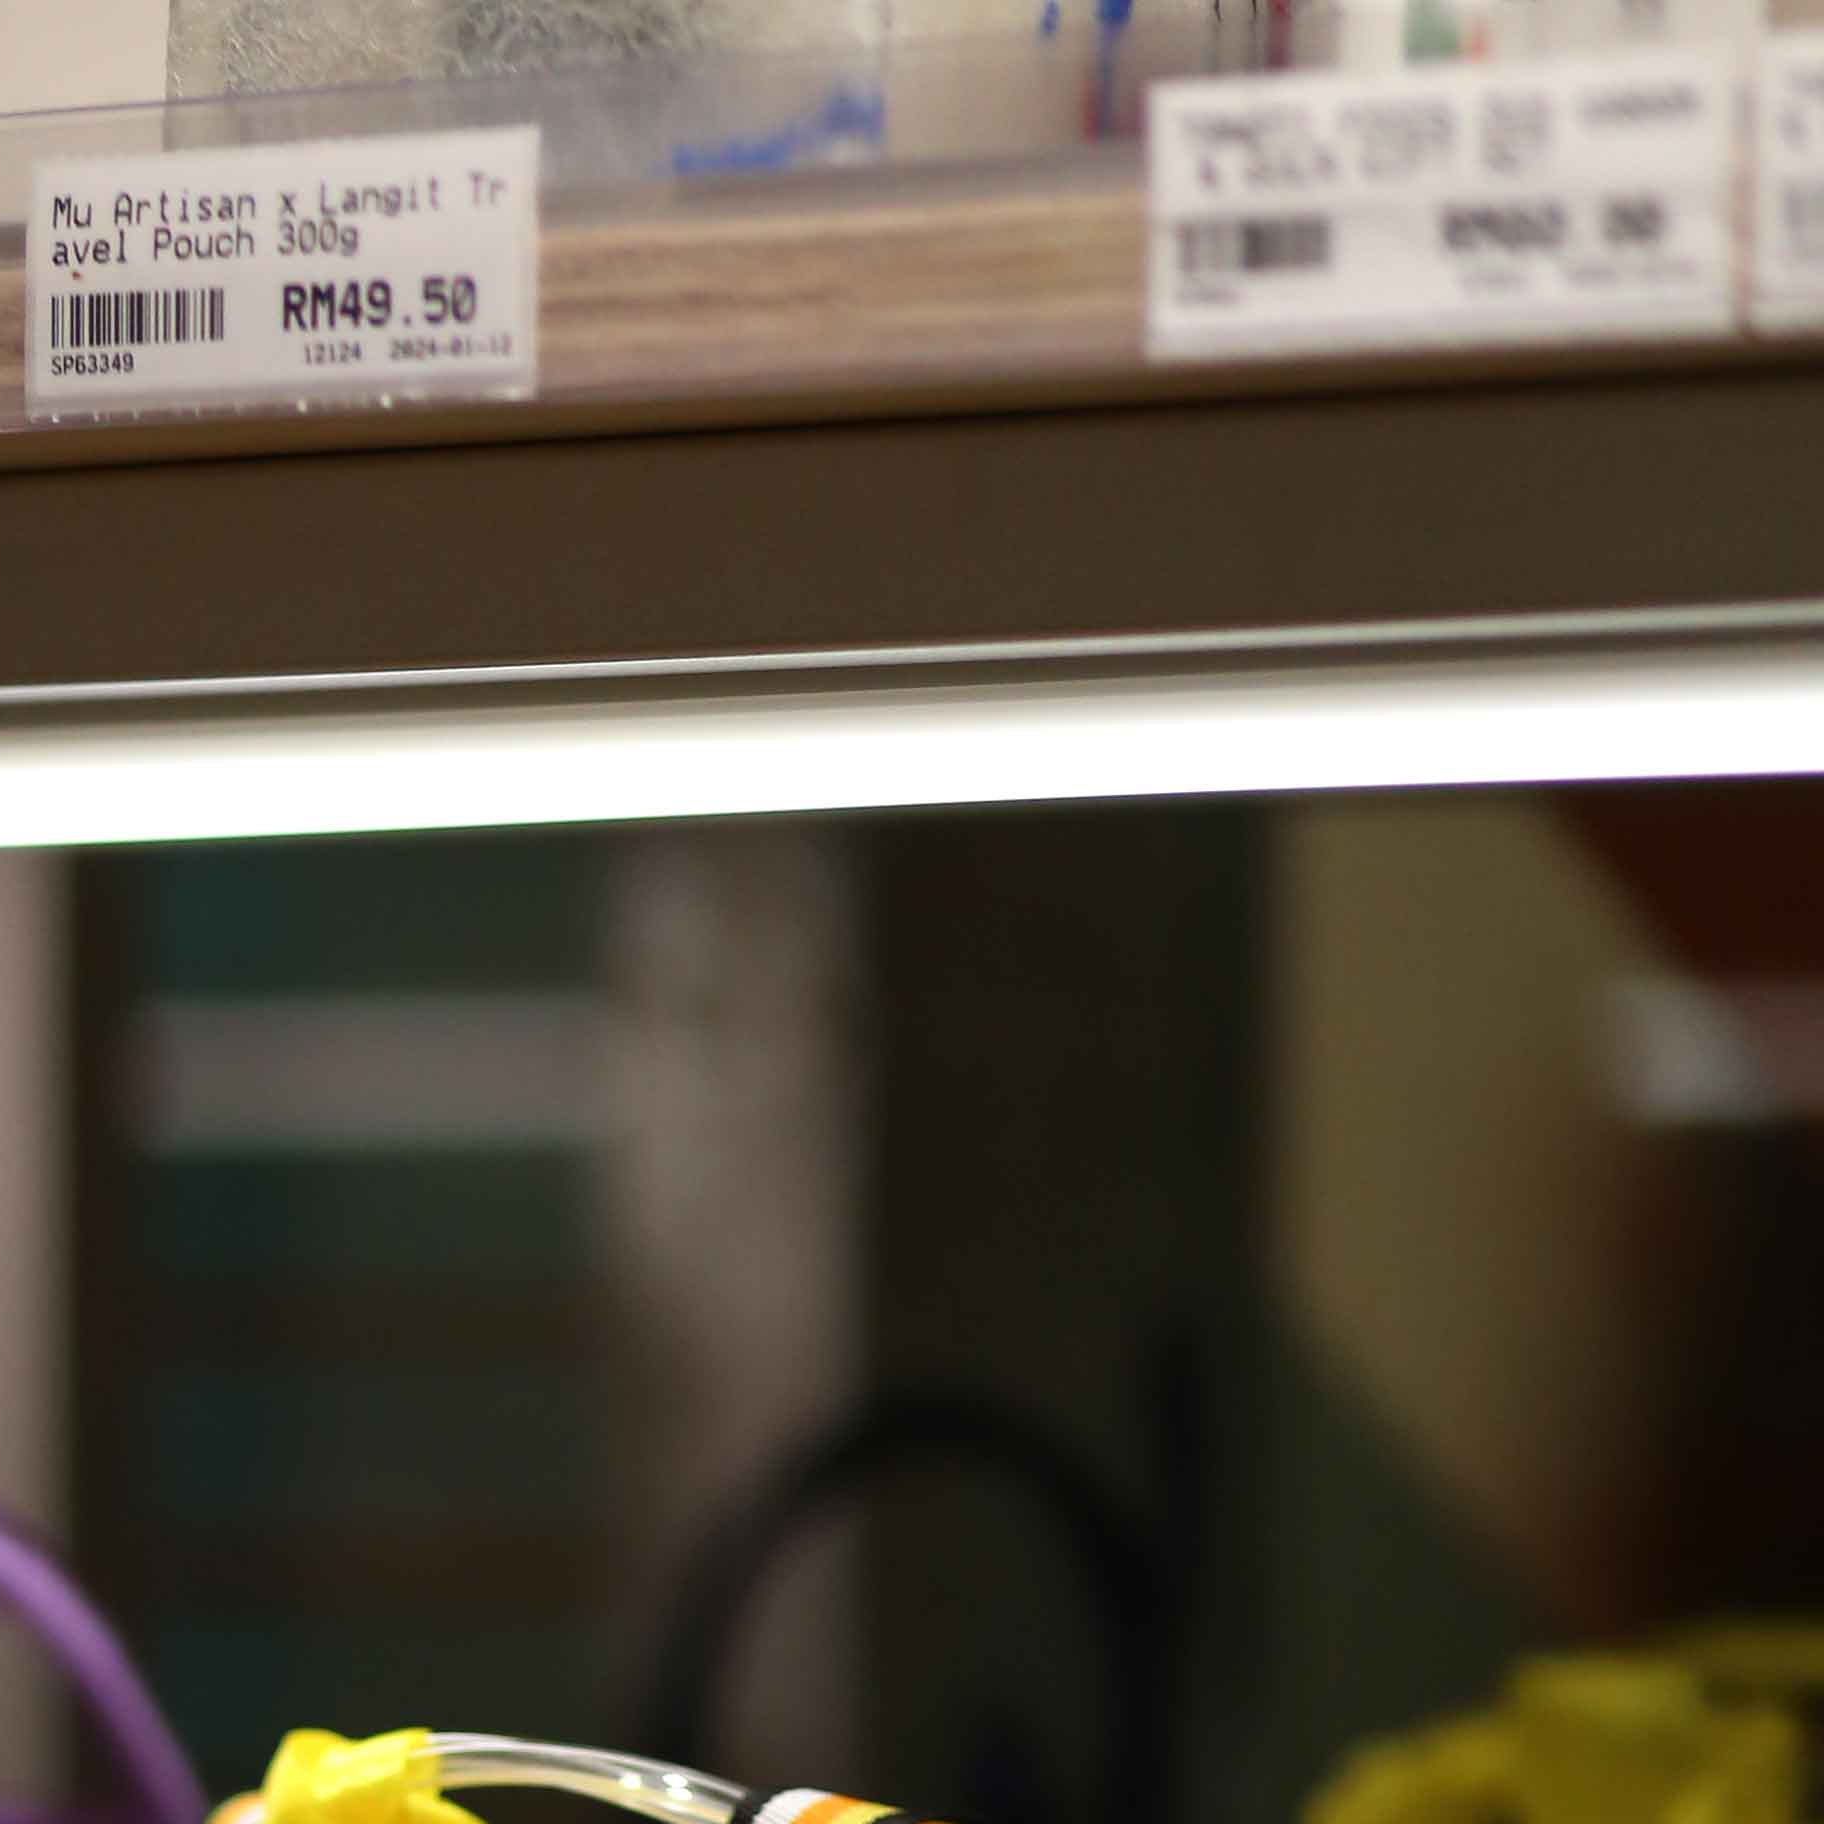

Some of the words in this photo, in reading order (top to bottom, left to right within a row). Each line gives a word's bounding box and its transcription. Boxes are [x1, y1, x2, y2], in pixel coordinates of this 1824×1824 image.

[51, 196, 92, 230] Mu
[113, 191, 256, 227] Artisan
[279, 193, 297, 216] x
[319, 176, 441, 219] Langit
[467, 172, 507, 205] Tr
[51, 230, 128, 267] avel
[152, 227, 256, 260] Pouch
[276, 219, 360, 257] 300g
[282, 277, 478, 332] RM49.50
[50, 352, 135, 375] SP63349
